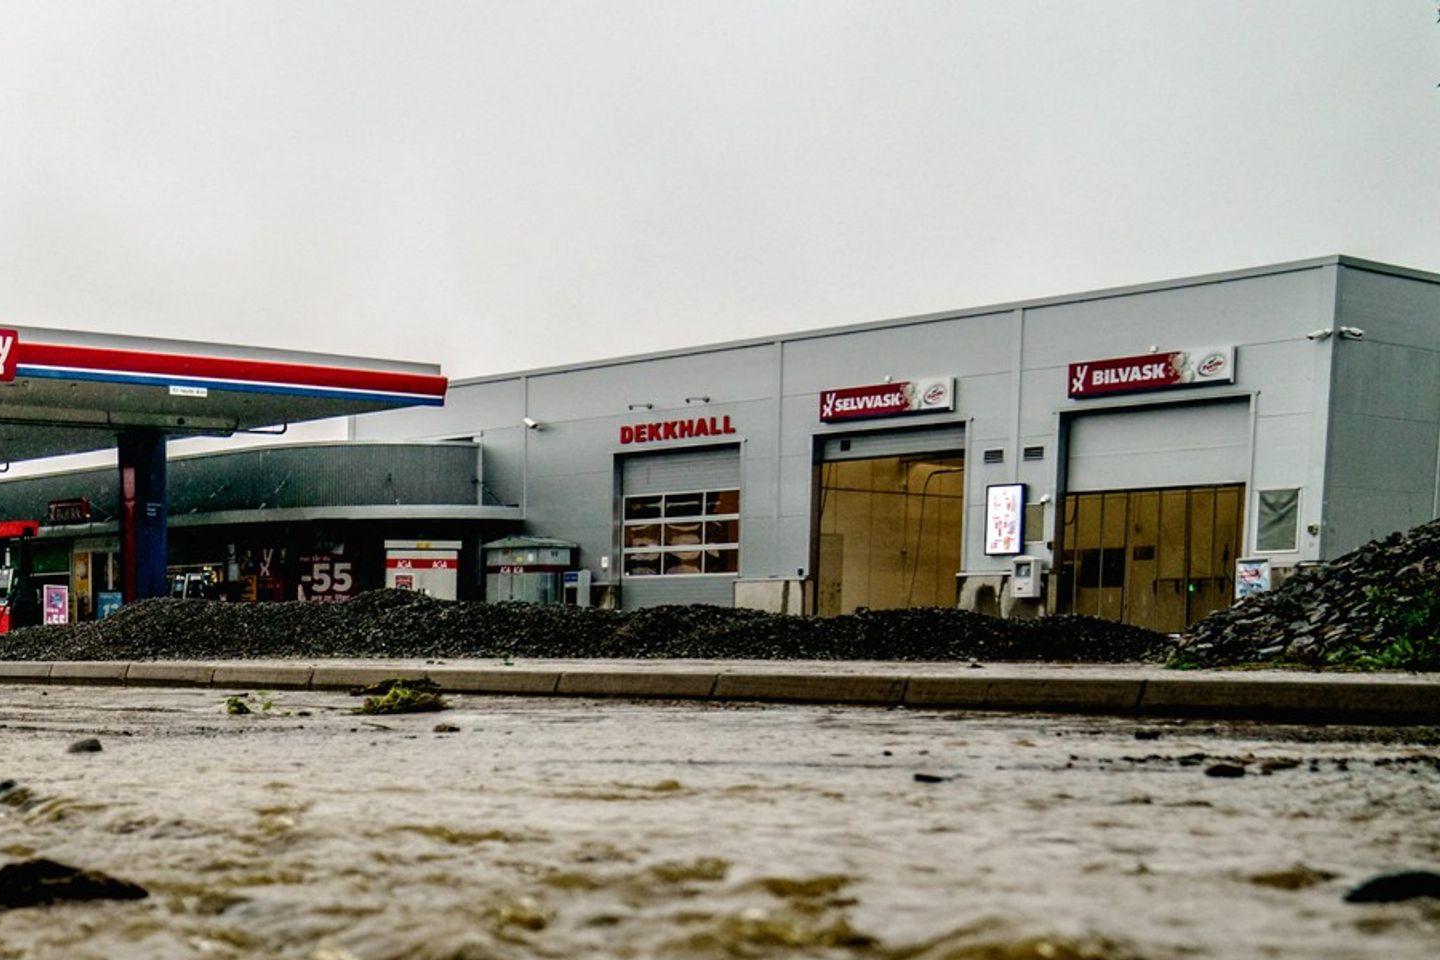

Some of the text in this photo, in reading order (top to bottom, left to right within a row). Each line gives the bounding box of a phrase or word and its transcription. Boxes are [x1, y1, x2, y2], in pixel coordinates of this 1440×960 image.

[1092, 362, 1166, 386] BILVASK
[835, 392, 901, 411] SELVVASK
[620, 415, 737, 444] DEKKHALL
[396, 560, 413, 569] AGA
[432, 560, 448, 569] AGA
[301, 562, 353, 592] -55
